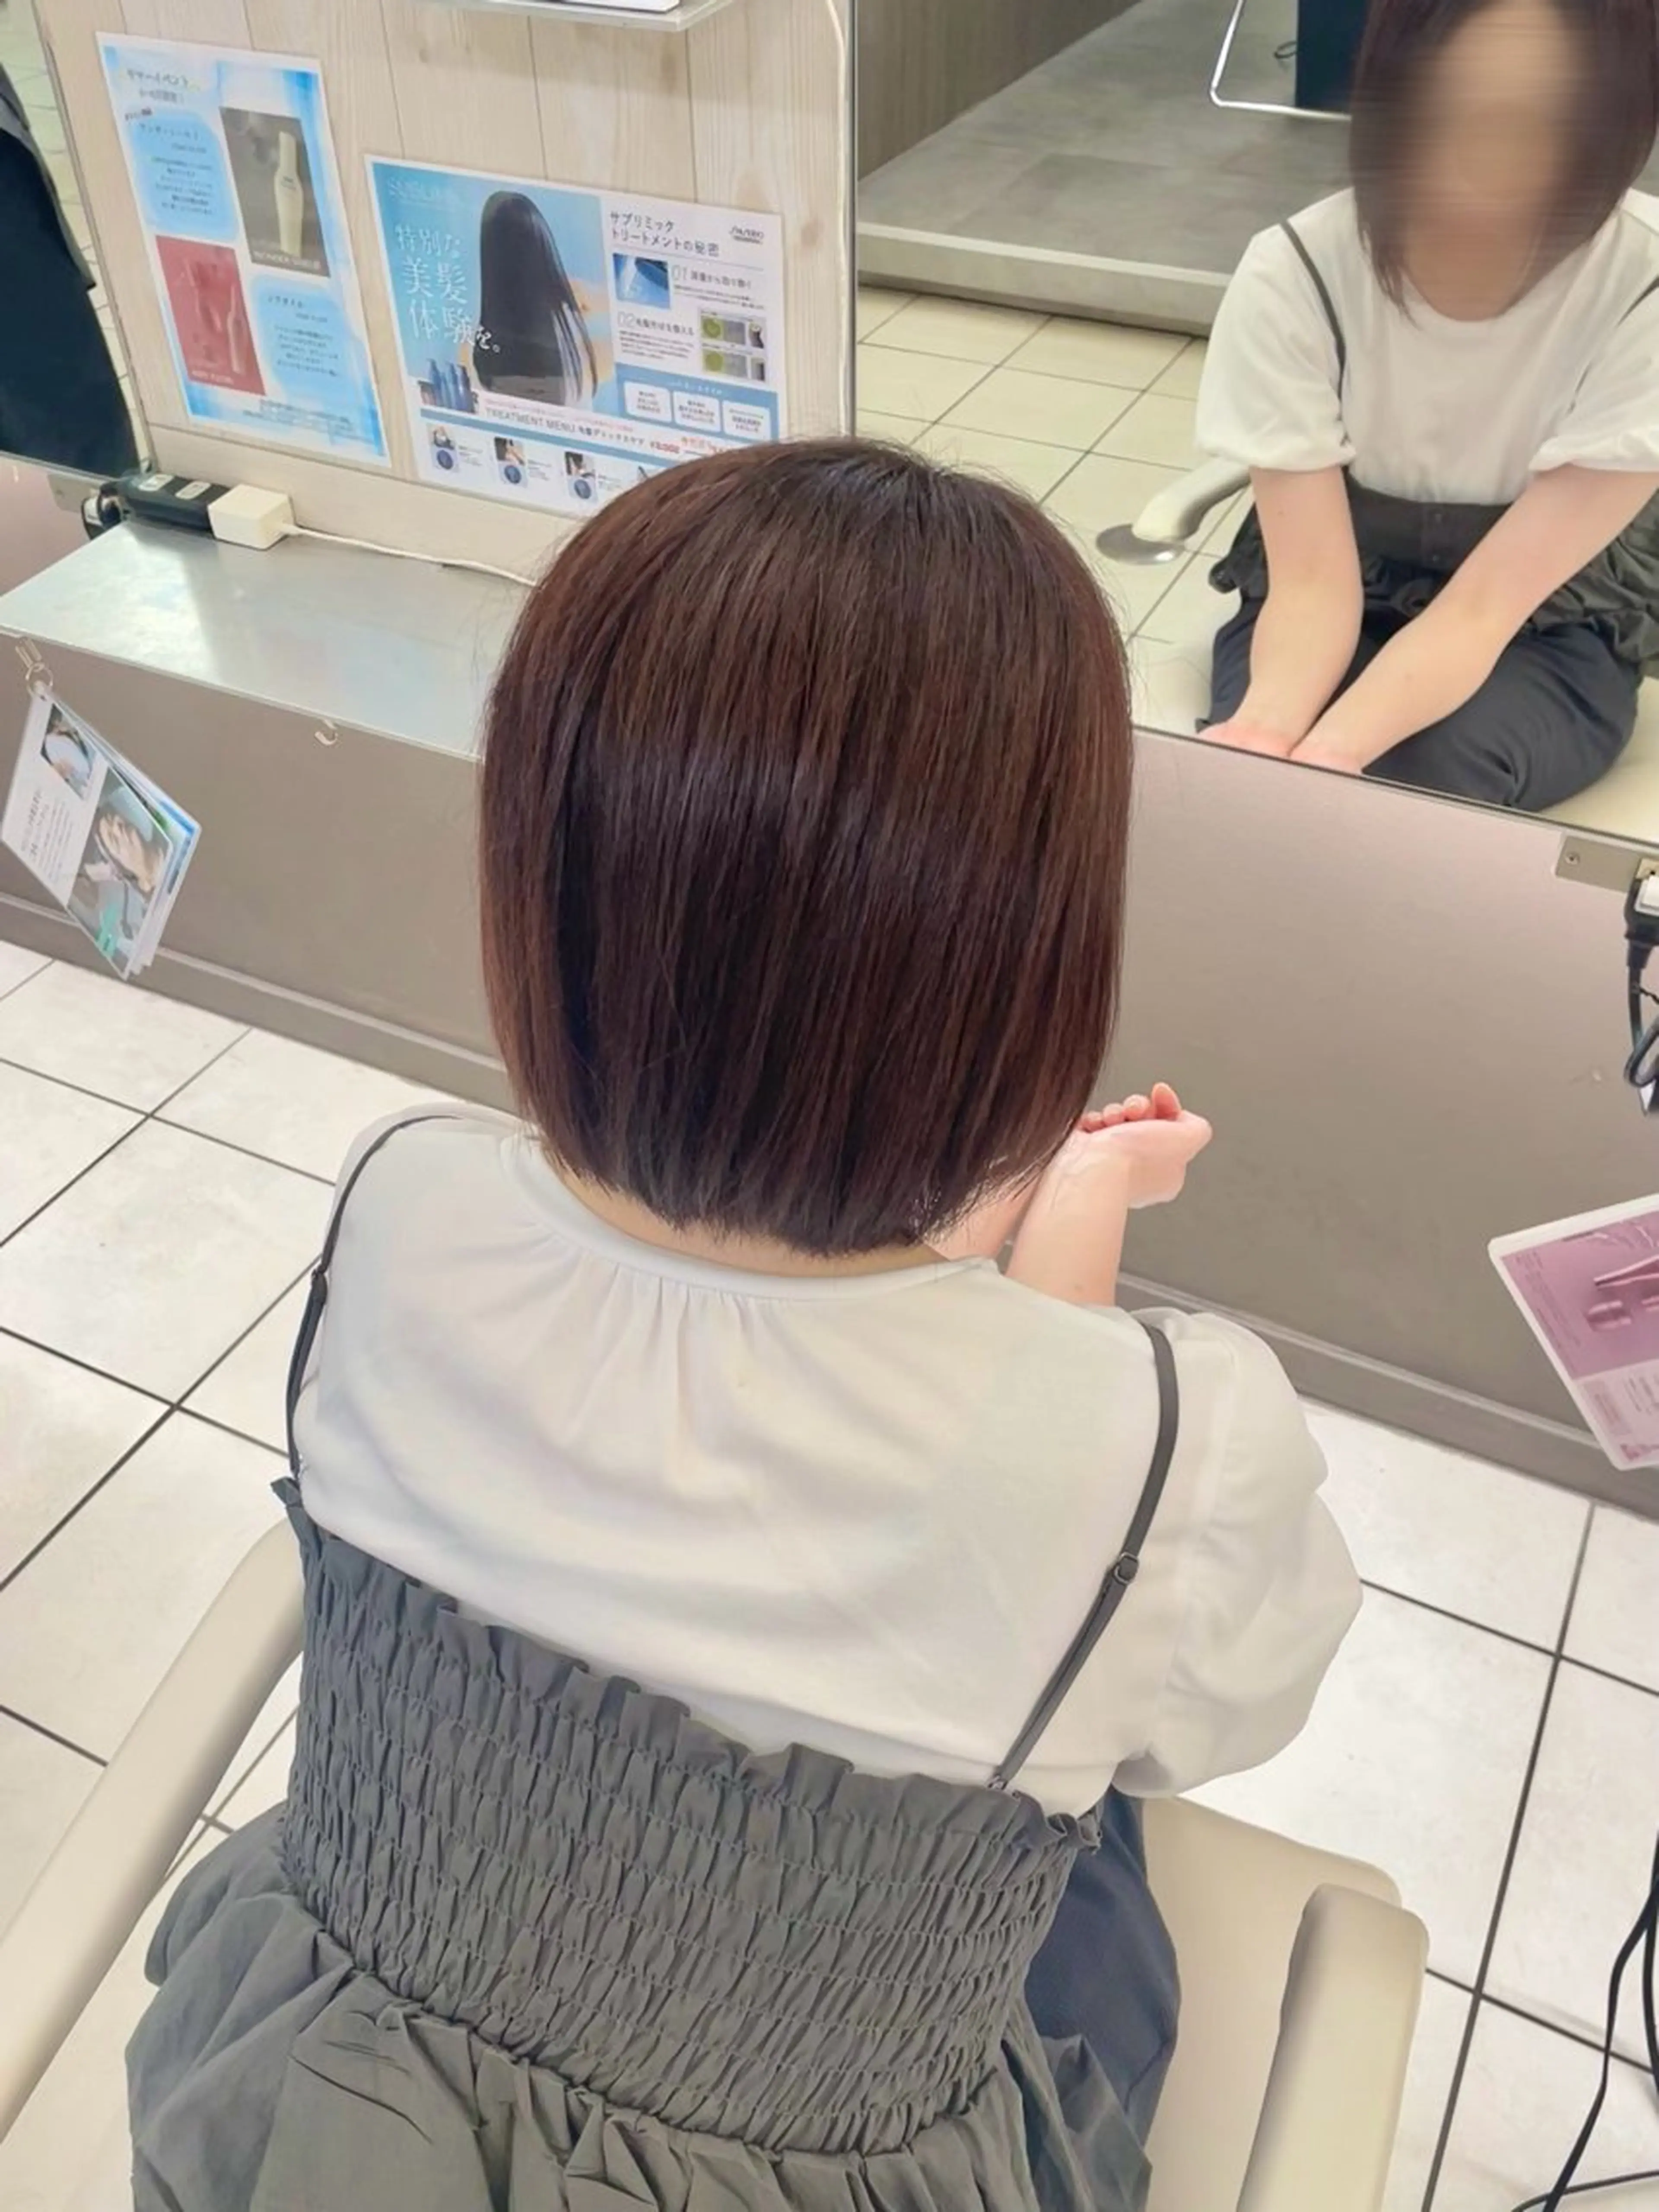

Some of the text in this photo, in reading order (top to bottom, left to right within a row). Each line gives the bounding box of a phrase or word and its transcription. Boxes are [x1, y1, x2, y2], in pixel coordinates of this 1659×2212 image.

[610, 211, 675, 233] サブリミック
[394, 224, 461, 259] 特別な
[612, 227, 720, 257] トリートメントの秘密
[402, 257, 468, 305] 美髪
[408, 299, 501, 353] 体験を。
[486, 407, 543, 427] TREATMENT
[546, 419, 575, 433] MENU
